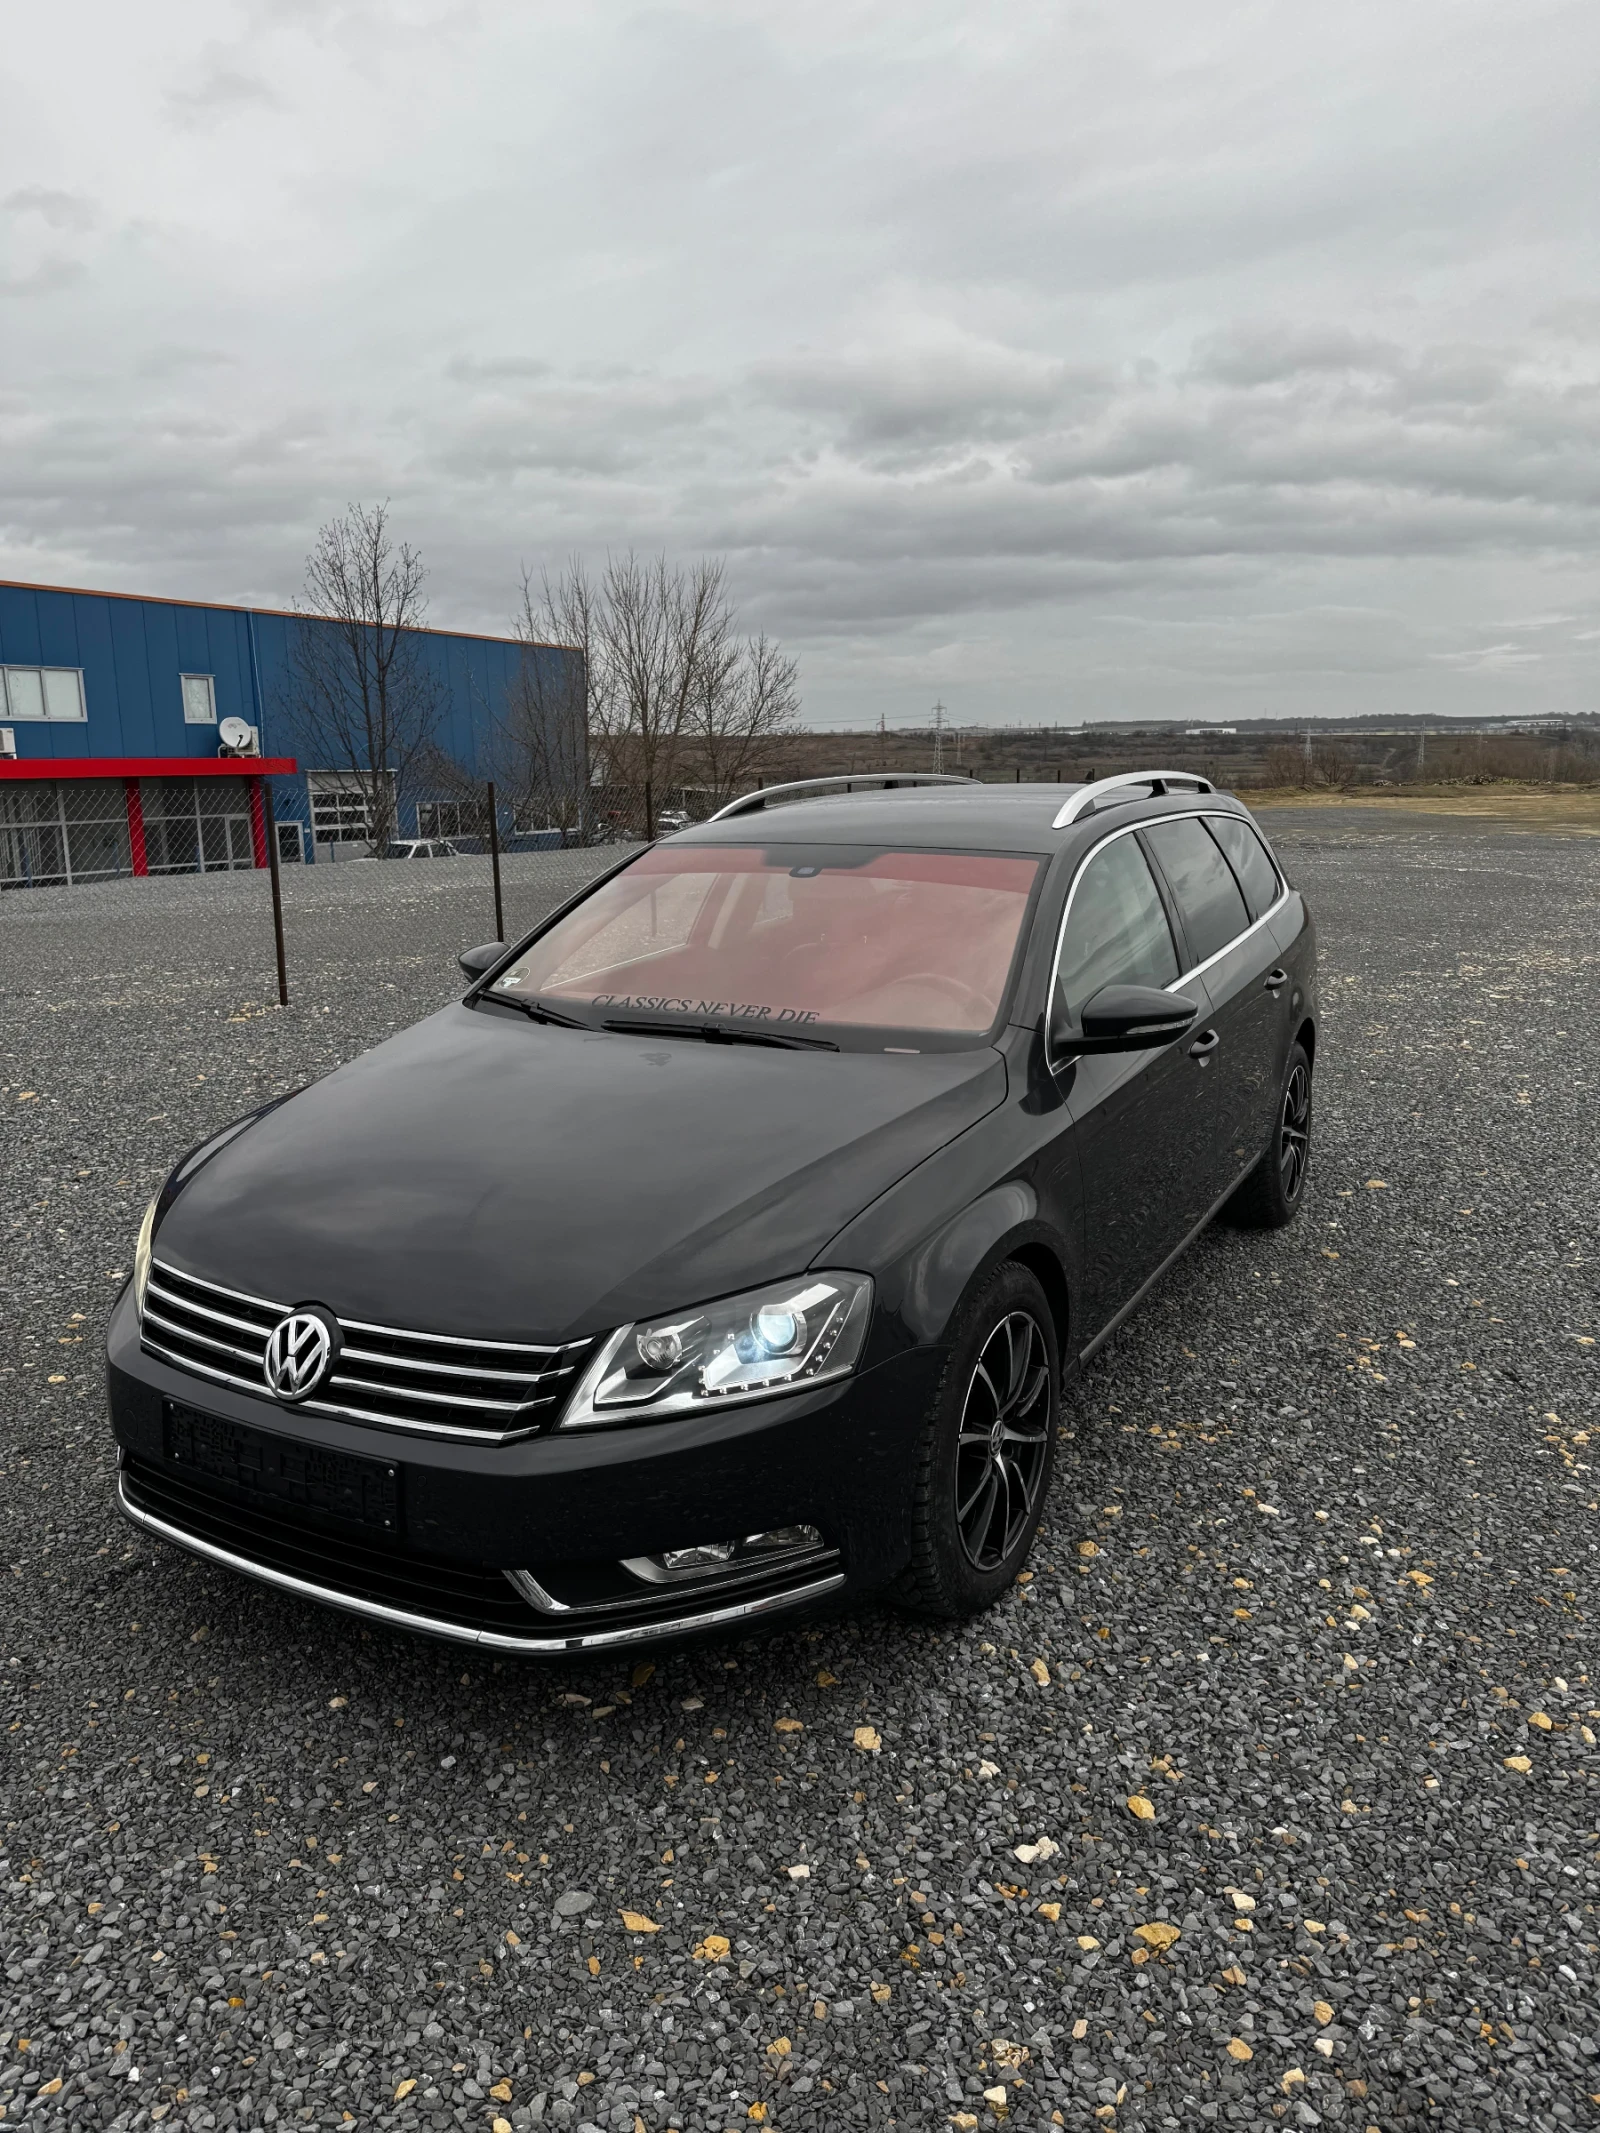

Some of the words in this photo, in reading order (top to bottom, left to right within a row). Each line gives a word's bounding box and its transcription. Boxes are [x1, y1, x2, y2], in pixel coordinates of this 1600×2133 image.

[591, 994, 692, 1012] CLASSICS
[694, 1000, 772, 1020] NEVER
[776, 1008, 820, 1025] DIE
[264, 1314, 331, 1400] VW
